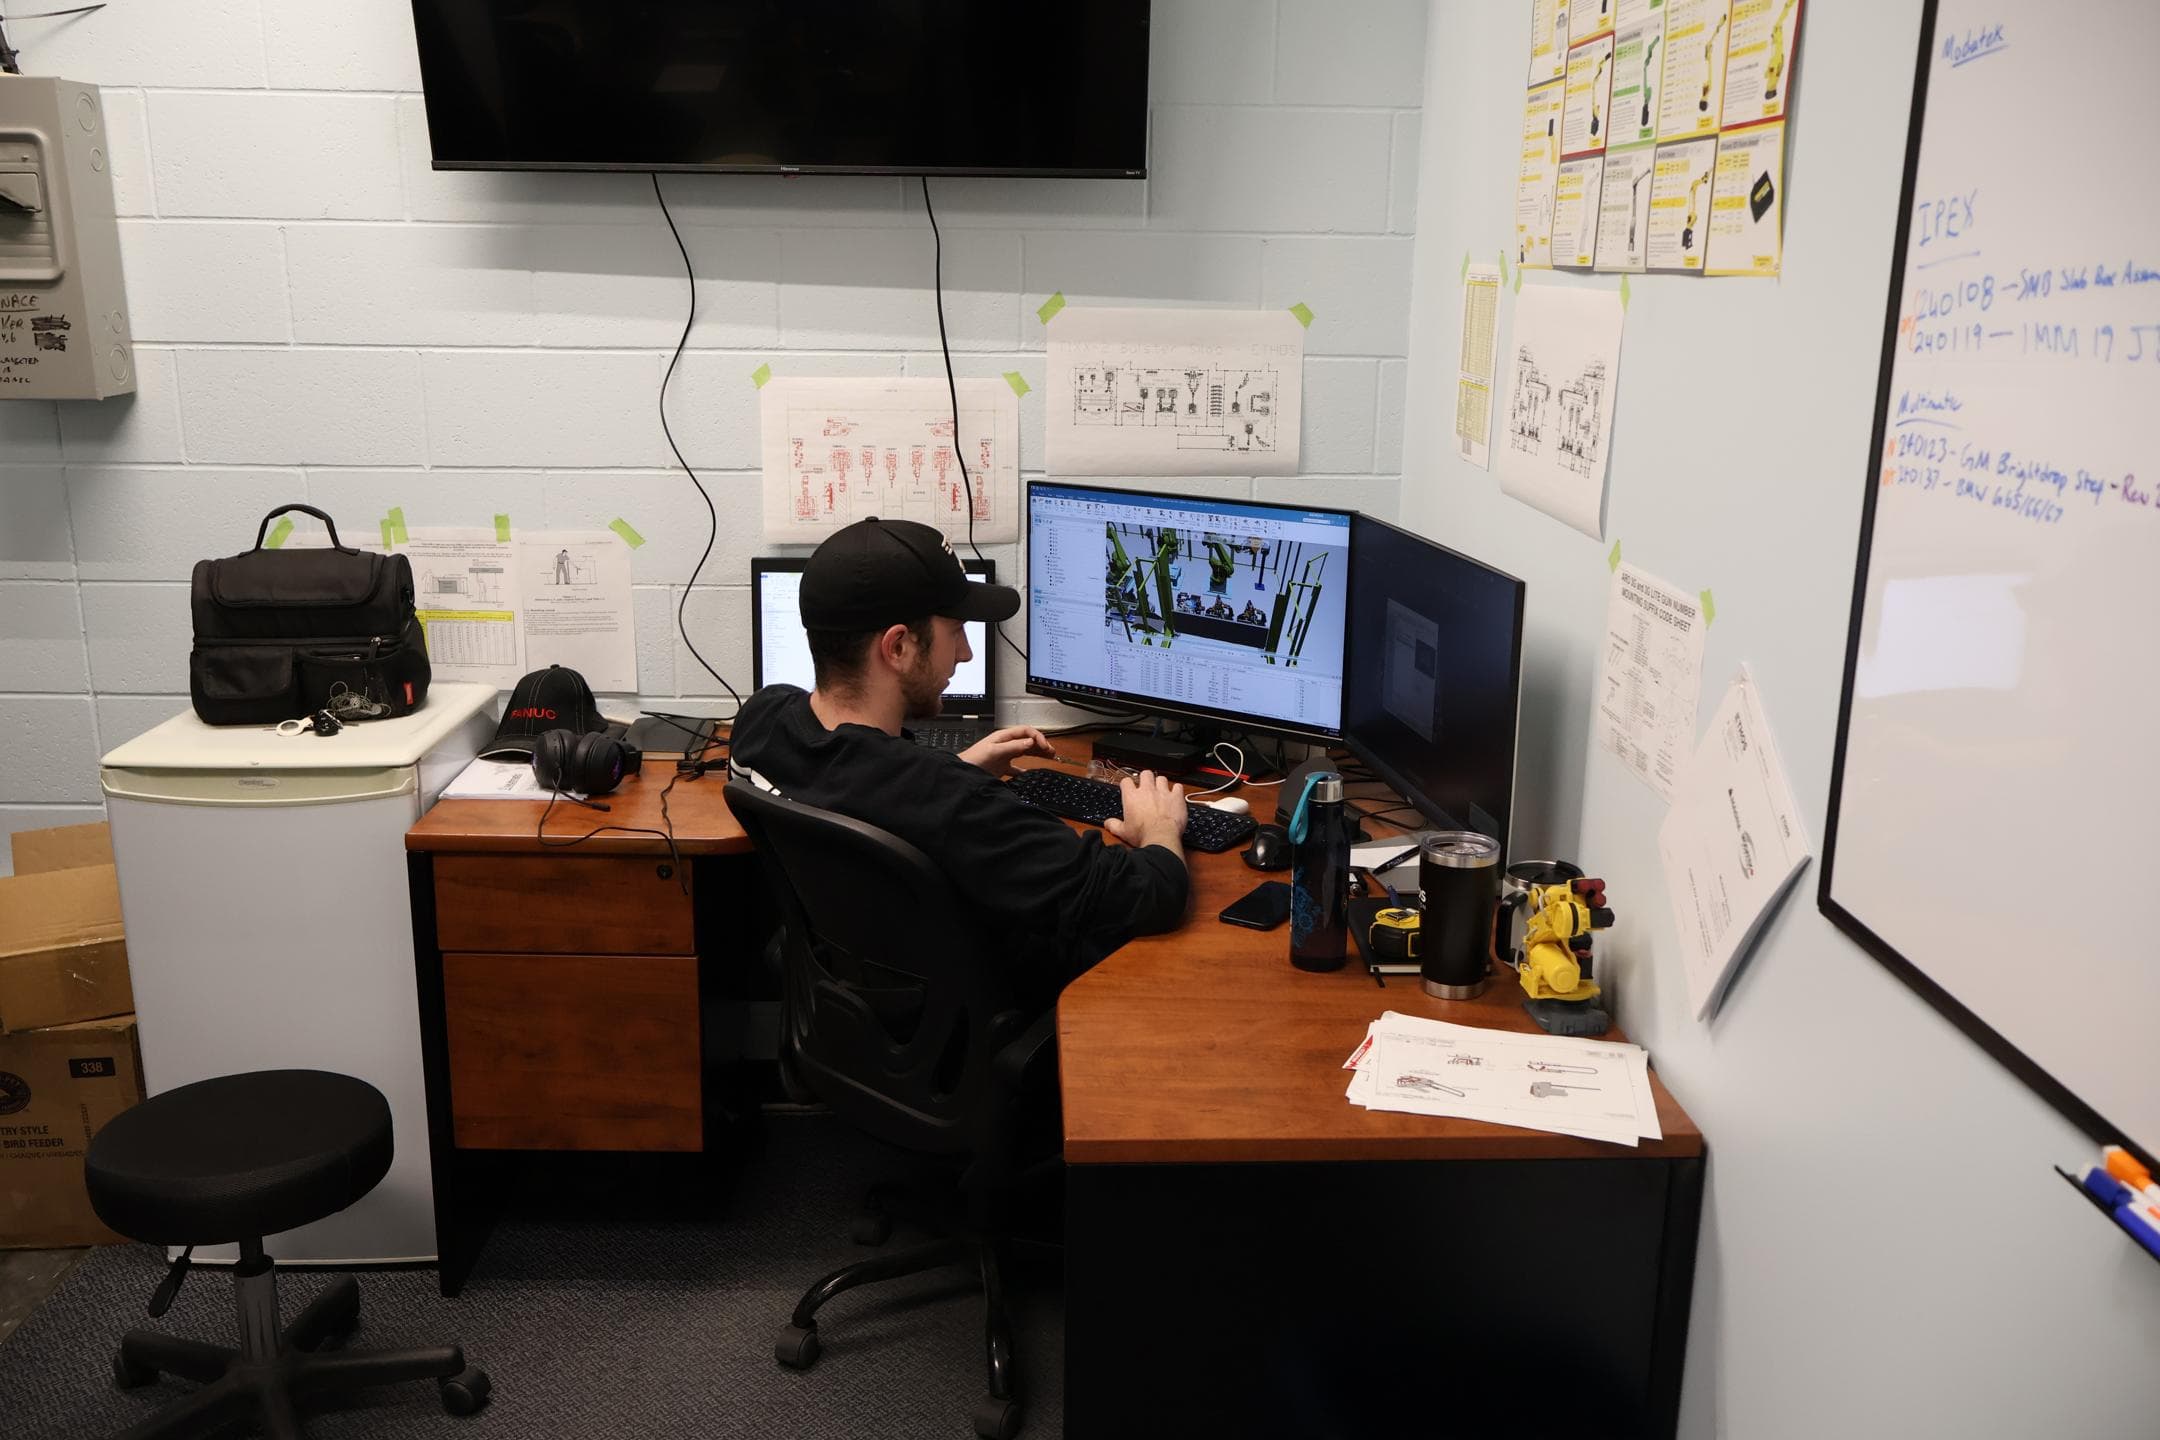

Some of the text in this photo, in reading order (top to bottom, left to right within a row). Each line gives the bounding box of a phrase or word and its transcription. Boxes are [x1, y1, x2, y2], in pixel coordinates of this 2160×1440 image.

[1919, 188, 1977, 247] IPEX
[1914, 321, 1983, 355] 240119
[510, 707, 558, 721] FANUC
[80, 1062, 104, 1074] 338
[19, 1125, 49, 1136] STYLE
[3, 1138, 64, 1149] BIRD FEEDER
